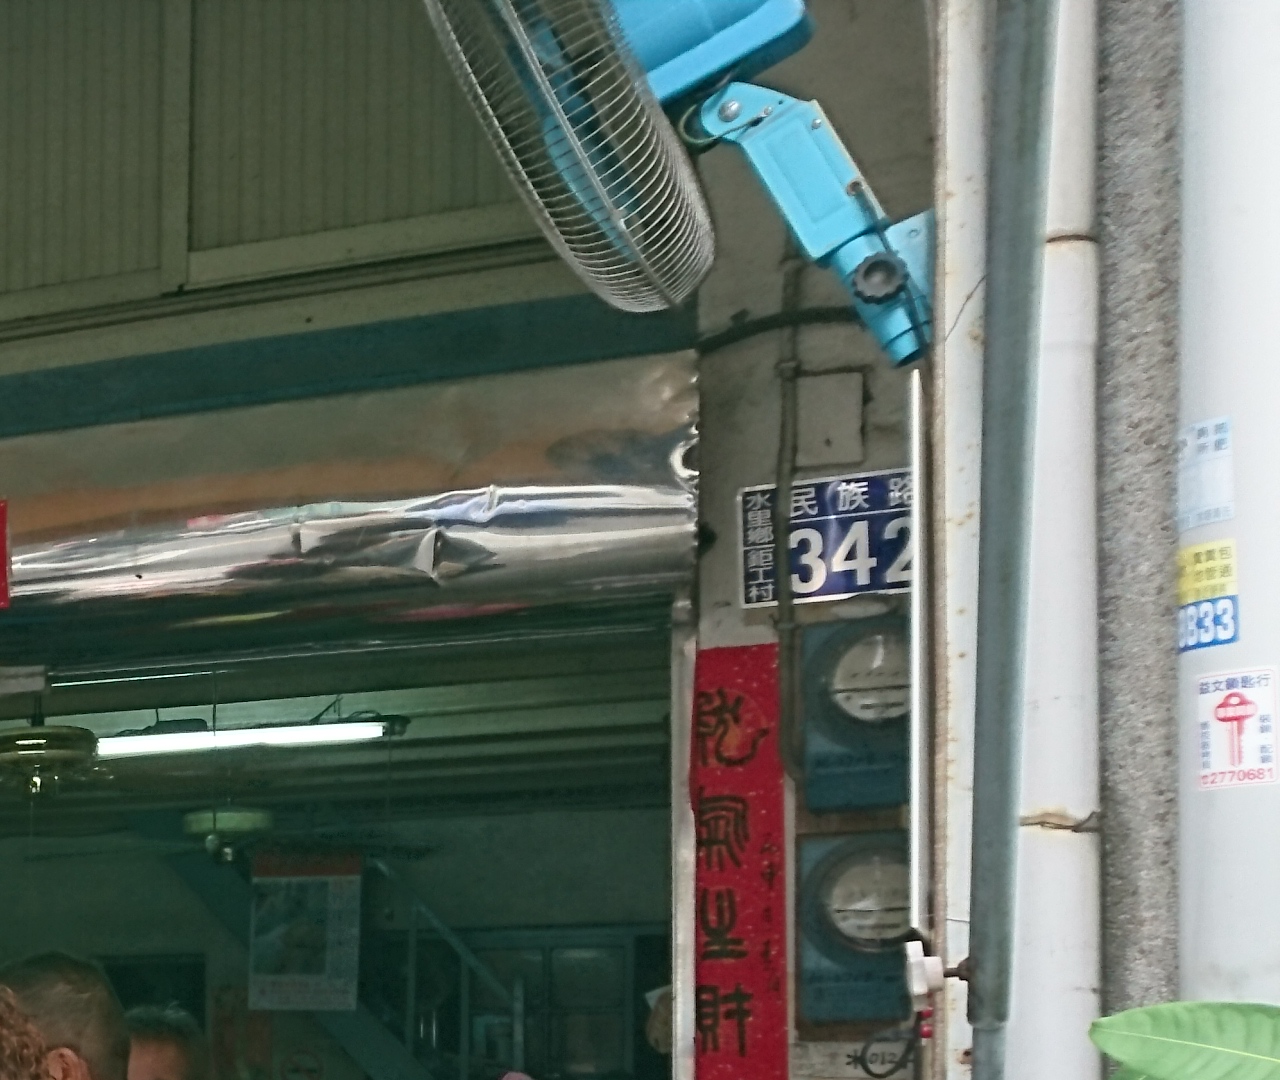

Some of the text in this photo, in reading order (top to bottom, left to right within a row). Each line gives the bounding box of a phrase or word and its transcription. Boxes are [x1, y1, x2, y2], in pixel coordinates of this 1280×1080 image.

[788, 476, 913, 517] 民族路
[789, 517, 913, 596] 342
